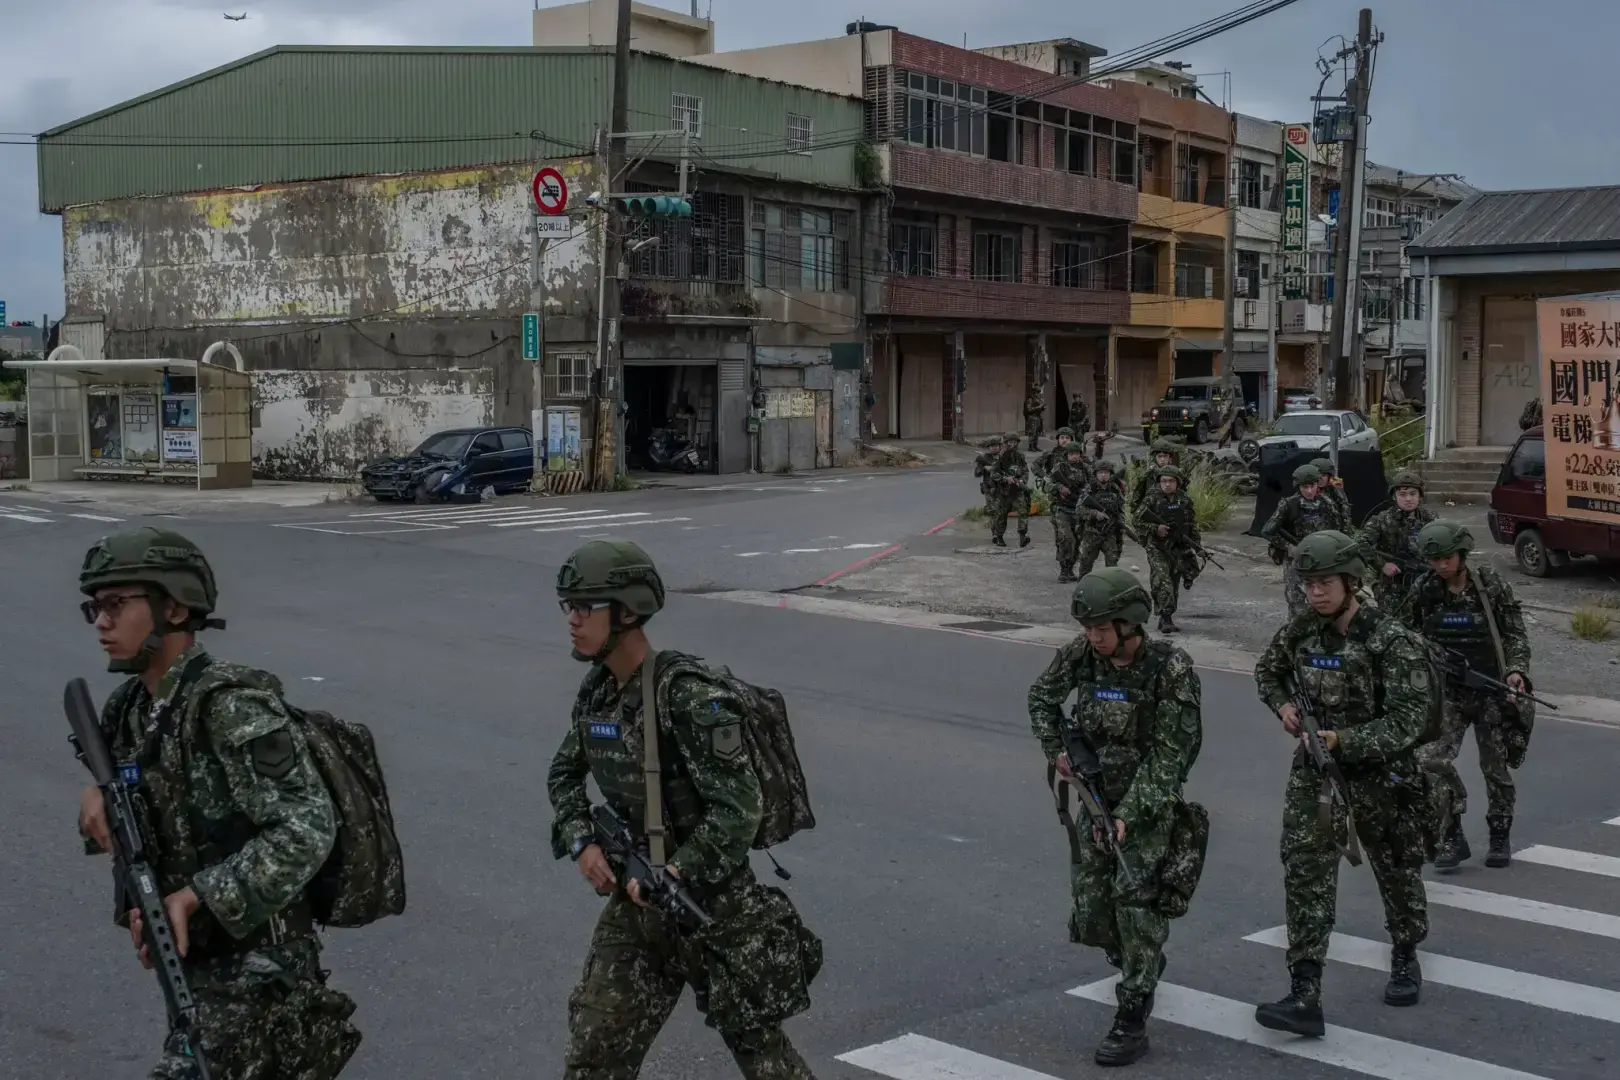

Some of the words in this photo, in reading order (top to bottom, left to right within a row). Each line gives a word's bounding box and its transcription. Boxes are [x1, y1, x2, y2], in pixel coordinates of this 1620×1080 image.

[1494, 364, 1534, 388] A12
[1550, 359, 1620, 408] 國門
[1551, 413, 1593, 444] 電梯
